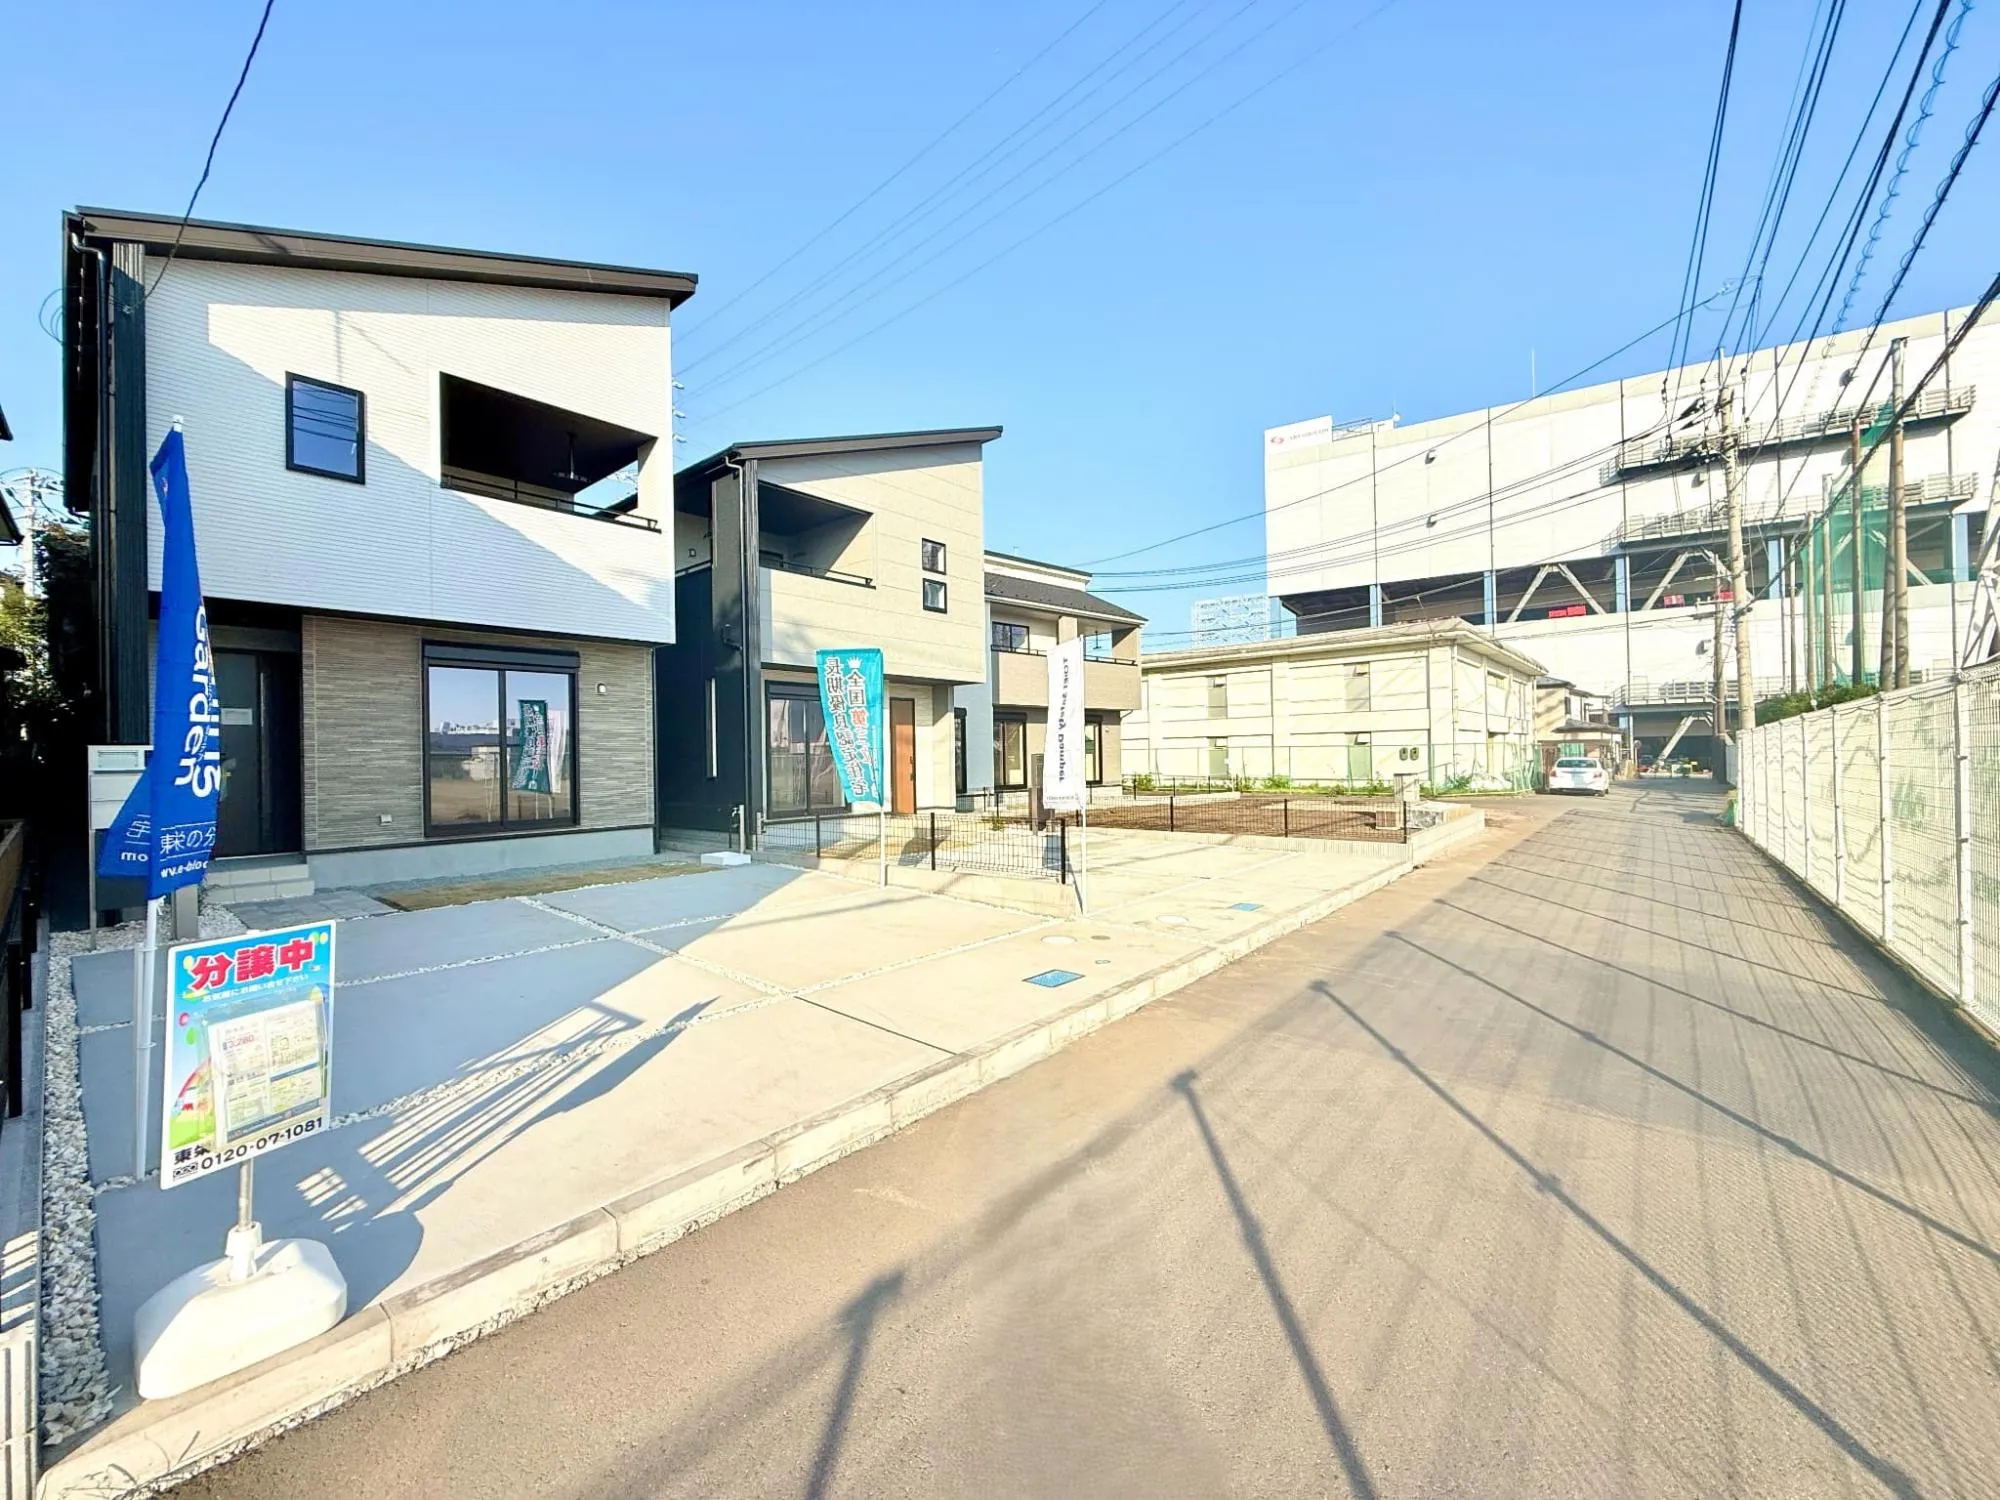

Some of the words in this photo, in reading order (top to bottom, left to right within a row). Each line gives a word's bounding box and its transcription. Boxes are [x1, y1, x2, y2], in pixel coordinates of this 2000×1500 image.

[174, 606, 210, 786] Garden
[190, 938, 314, 991] 分譲中
[201, 1117, 322, 1169] 0120-07-1081
